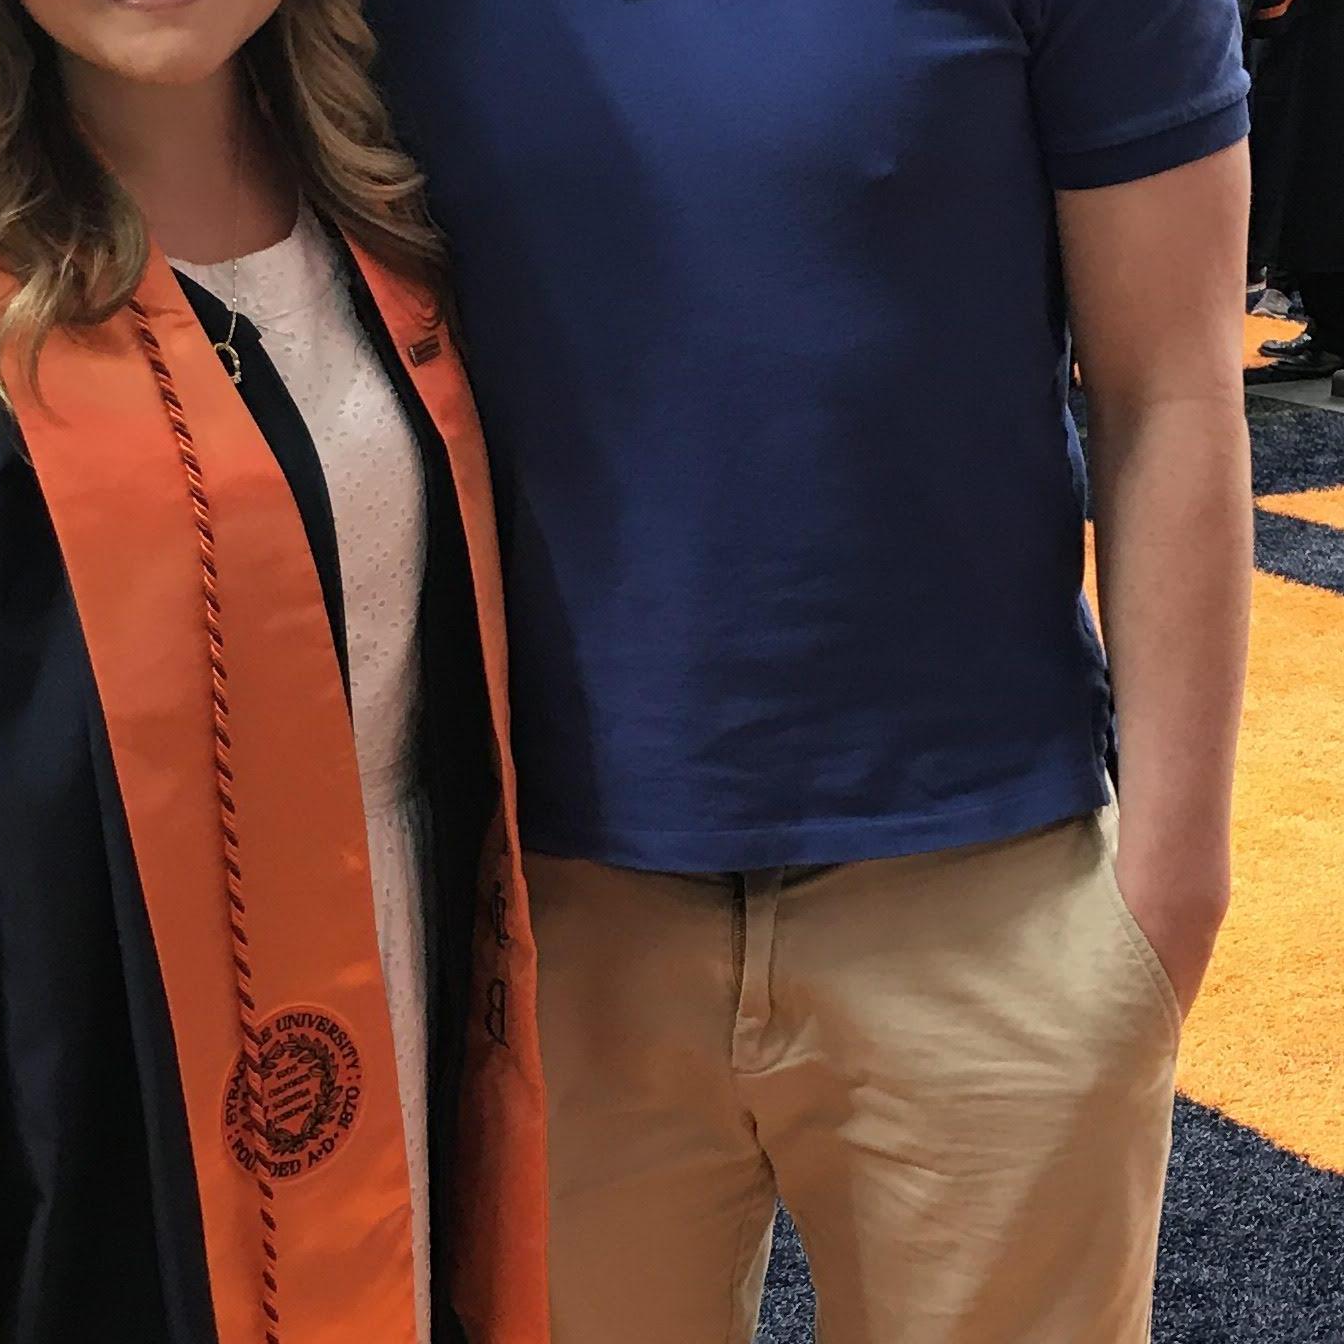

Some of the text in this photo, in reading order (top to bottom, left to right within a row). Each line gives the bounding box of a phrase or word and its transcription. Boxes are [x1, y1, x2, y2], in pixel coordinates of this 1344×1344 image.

[276, 1012, 360, 1071] UNIVERSITY
[231, 1137, 302, 1177] FOUDED
[338, 1085, 361, 1130] 1870
